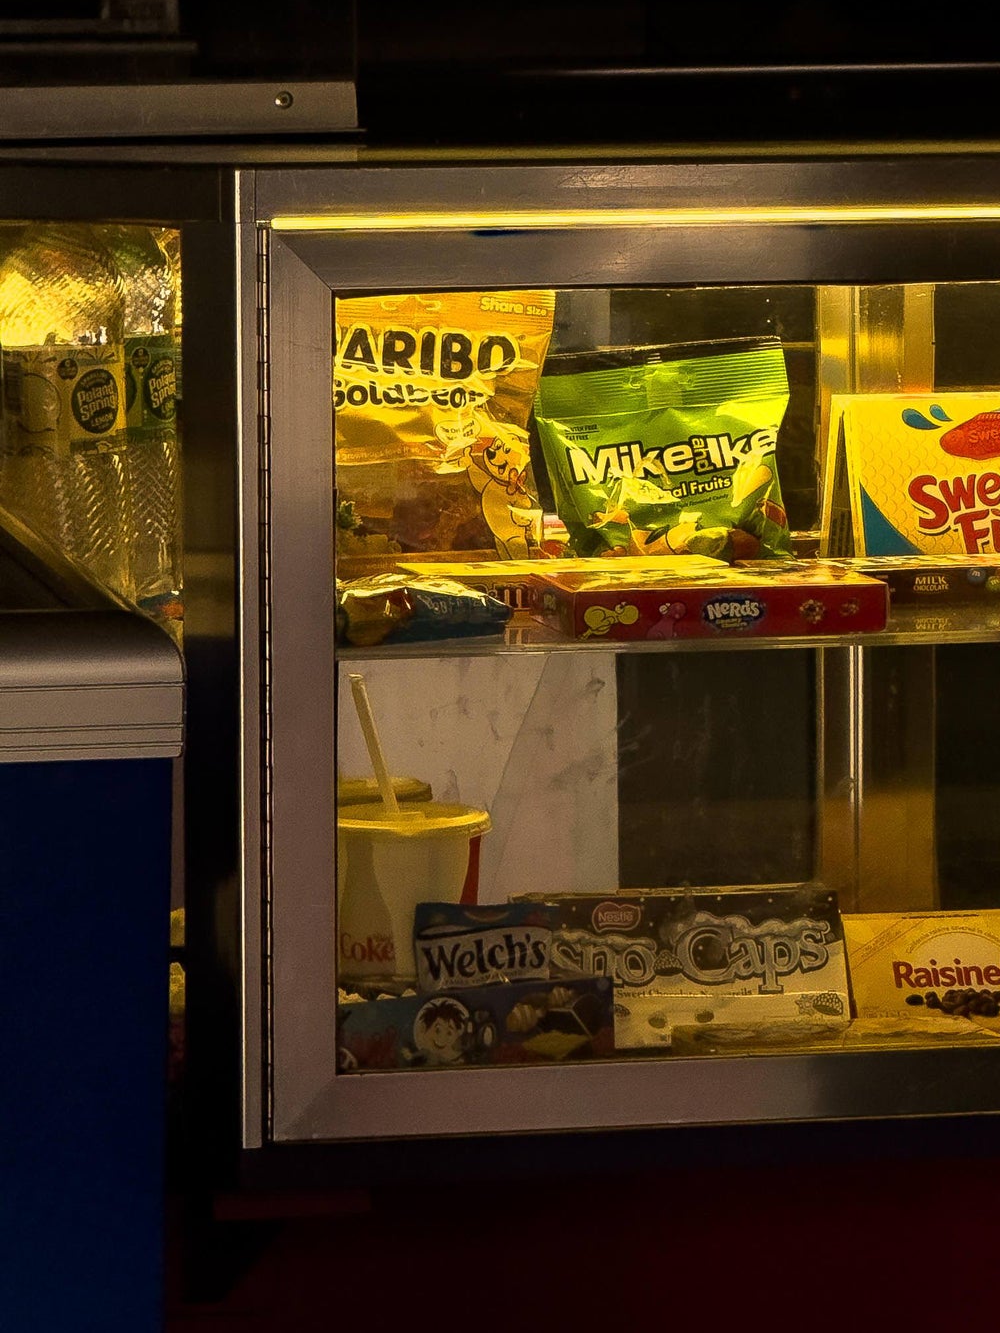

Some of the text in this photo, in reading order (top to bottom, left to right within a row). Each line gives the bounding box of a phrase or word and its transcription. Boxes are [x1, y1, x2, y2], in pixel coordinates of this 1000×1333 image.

[480, 296, 547, 317] Share Size
[334, 327, 516, 380] ARIBO
[569, 442, 694, 485] Mike
[690, 437, 709, 472] and
[706, 427, 778, 469] Ike
[688, 476, 732, 496] Fruits
[913, 583, 949, 592] CHOCOLATE
[915, 575, 947, 585] MILK
[421, 933, 547, 981] Welch's
[676, 925, 830, 994] Caps
